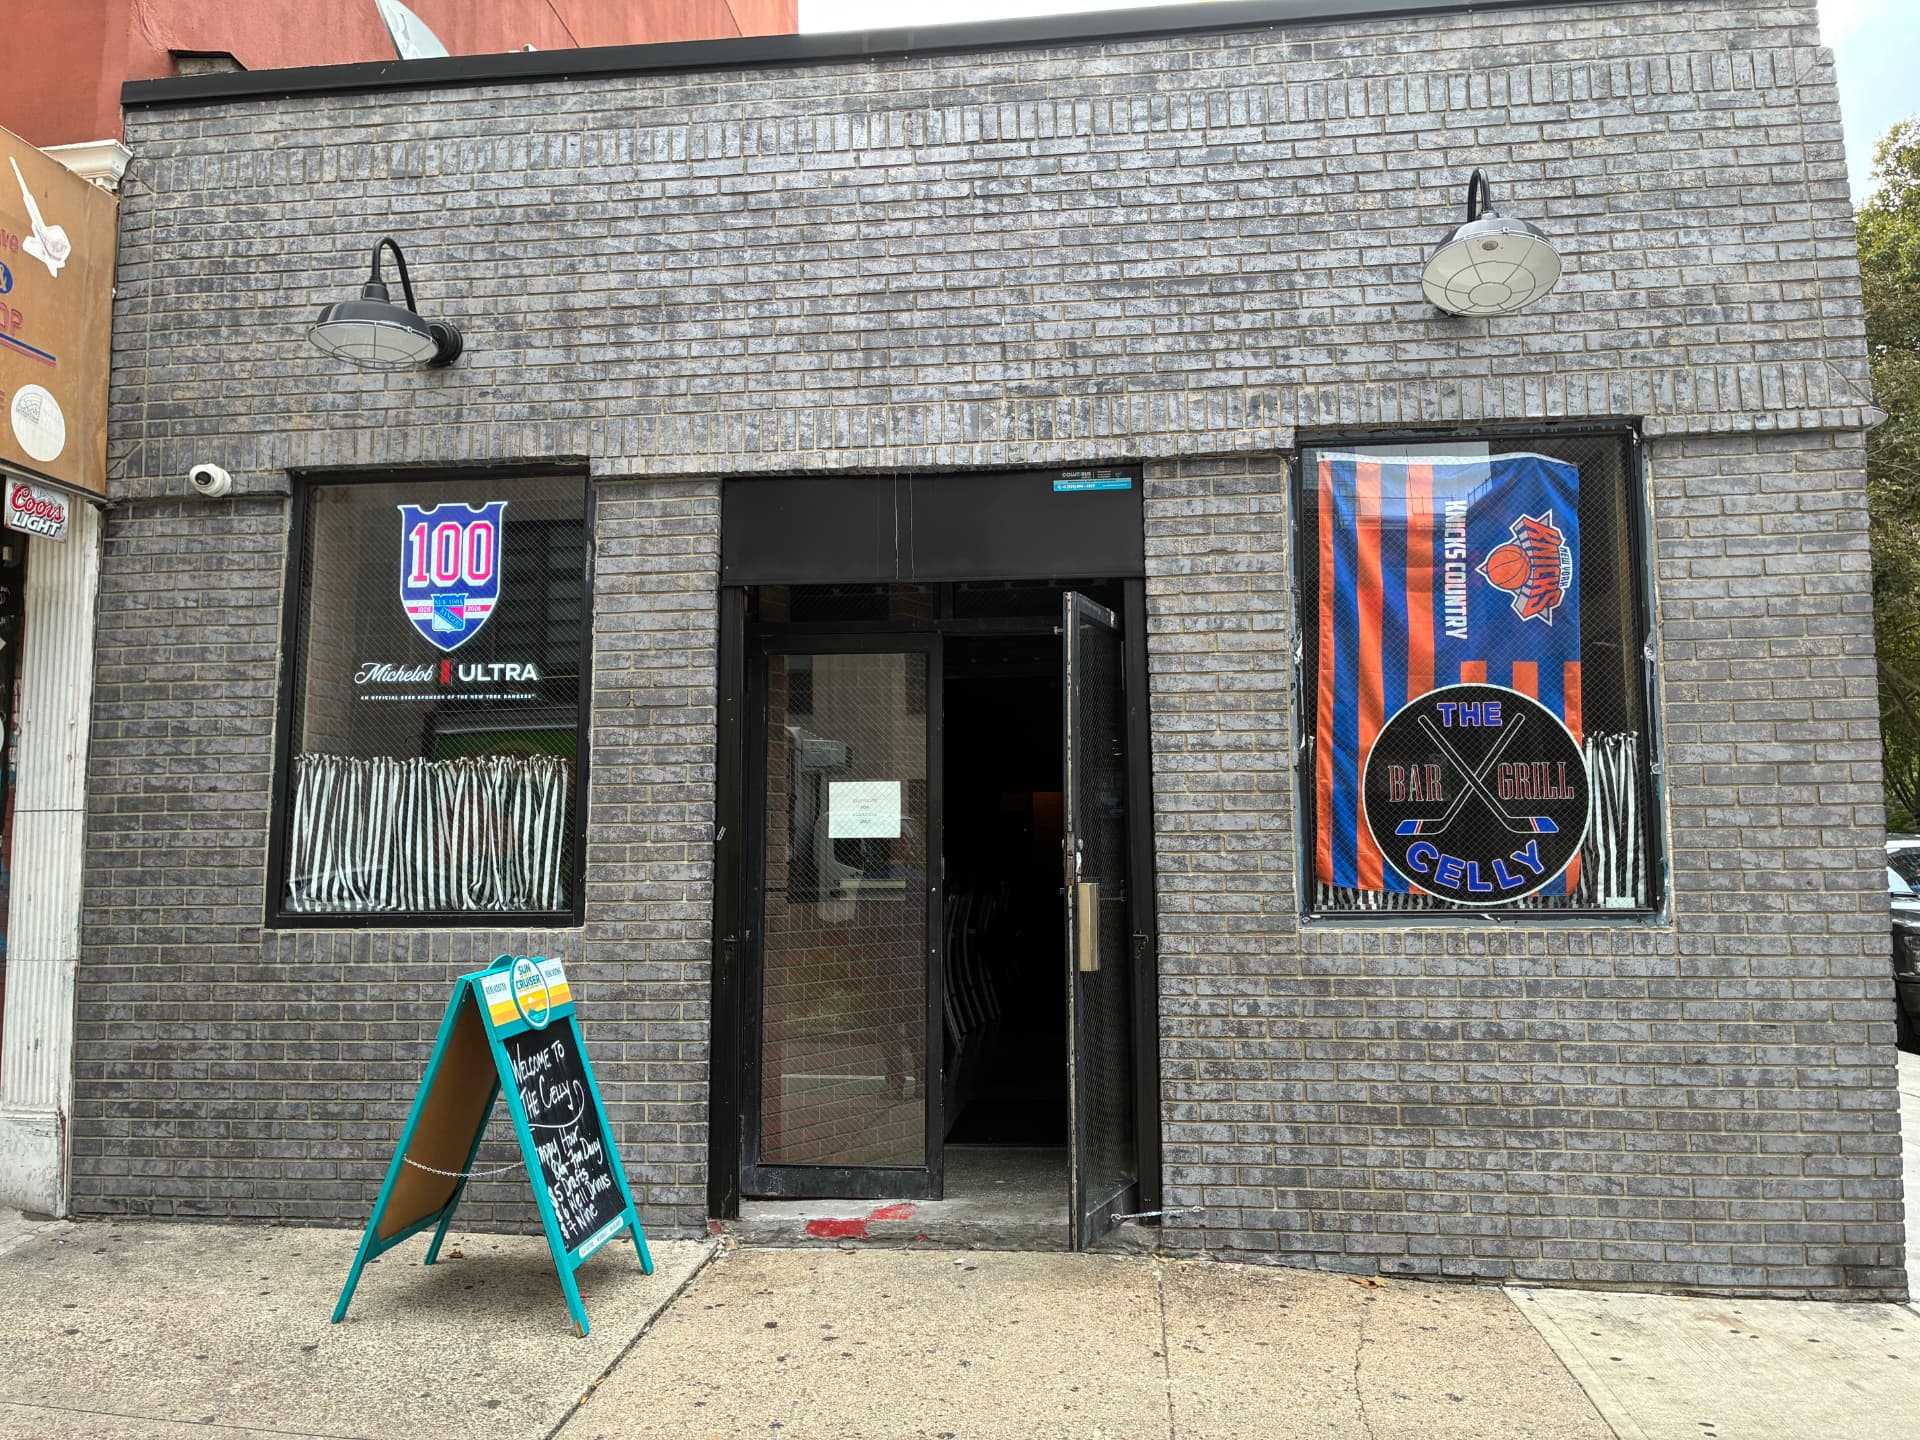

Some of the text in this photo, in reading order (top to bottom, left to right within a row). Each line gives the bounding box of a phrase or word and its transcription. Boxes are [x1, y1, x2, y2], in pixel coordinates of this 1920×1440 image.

[11, 482, 64, 522] Coors
[12, 511, 61, 537] LIGHT
[408, 521, 495, 588] 100
[1444, 500, 1468, 640] KNICKS COUNTRY
[1520, 518, 1563, 619] KNICKS
[1559, 547, 1572, 588] NEW YORK
[354, 662, 538, 684] Michelob ULTRA
[1437, 702, 1502, 727] THE
[1388, 762, 1574, 802] BAR GRILL
[1406, 840, 1545, 892] CELLY
[515, 974, 541, 990] CRUISER
[517, 963, 532, 976] SUN
[520, 1086, 540, 1121] THE
[561, 1167, 589, 1198] Drafts
[568, 1186, 589, 1215] Well
[585, 1173, 611, 1201] Drinks
